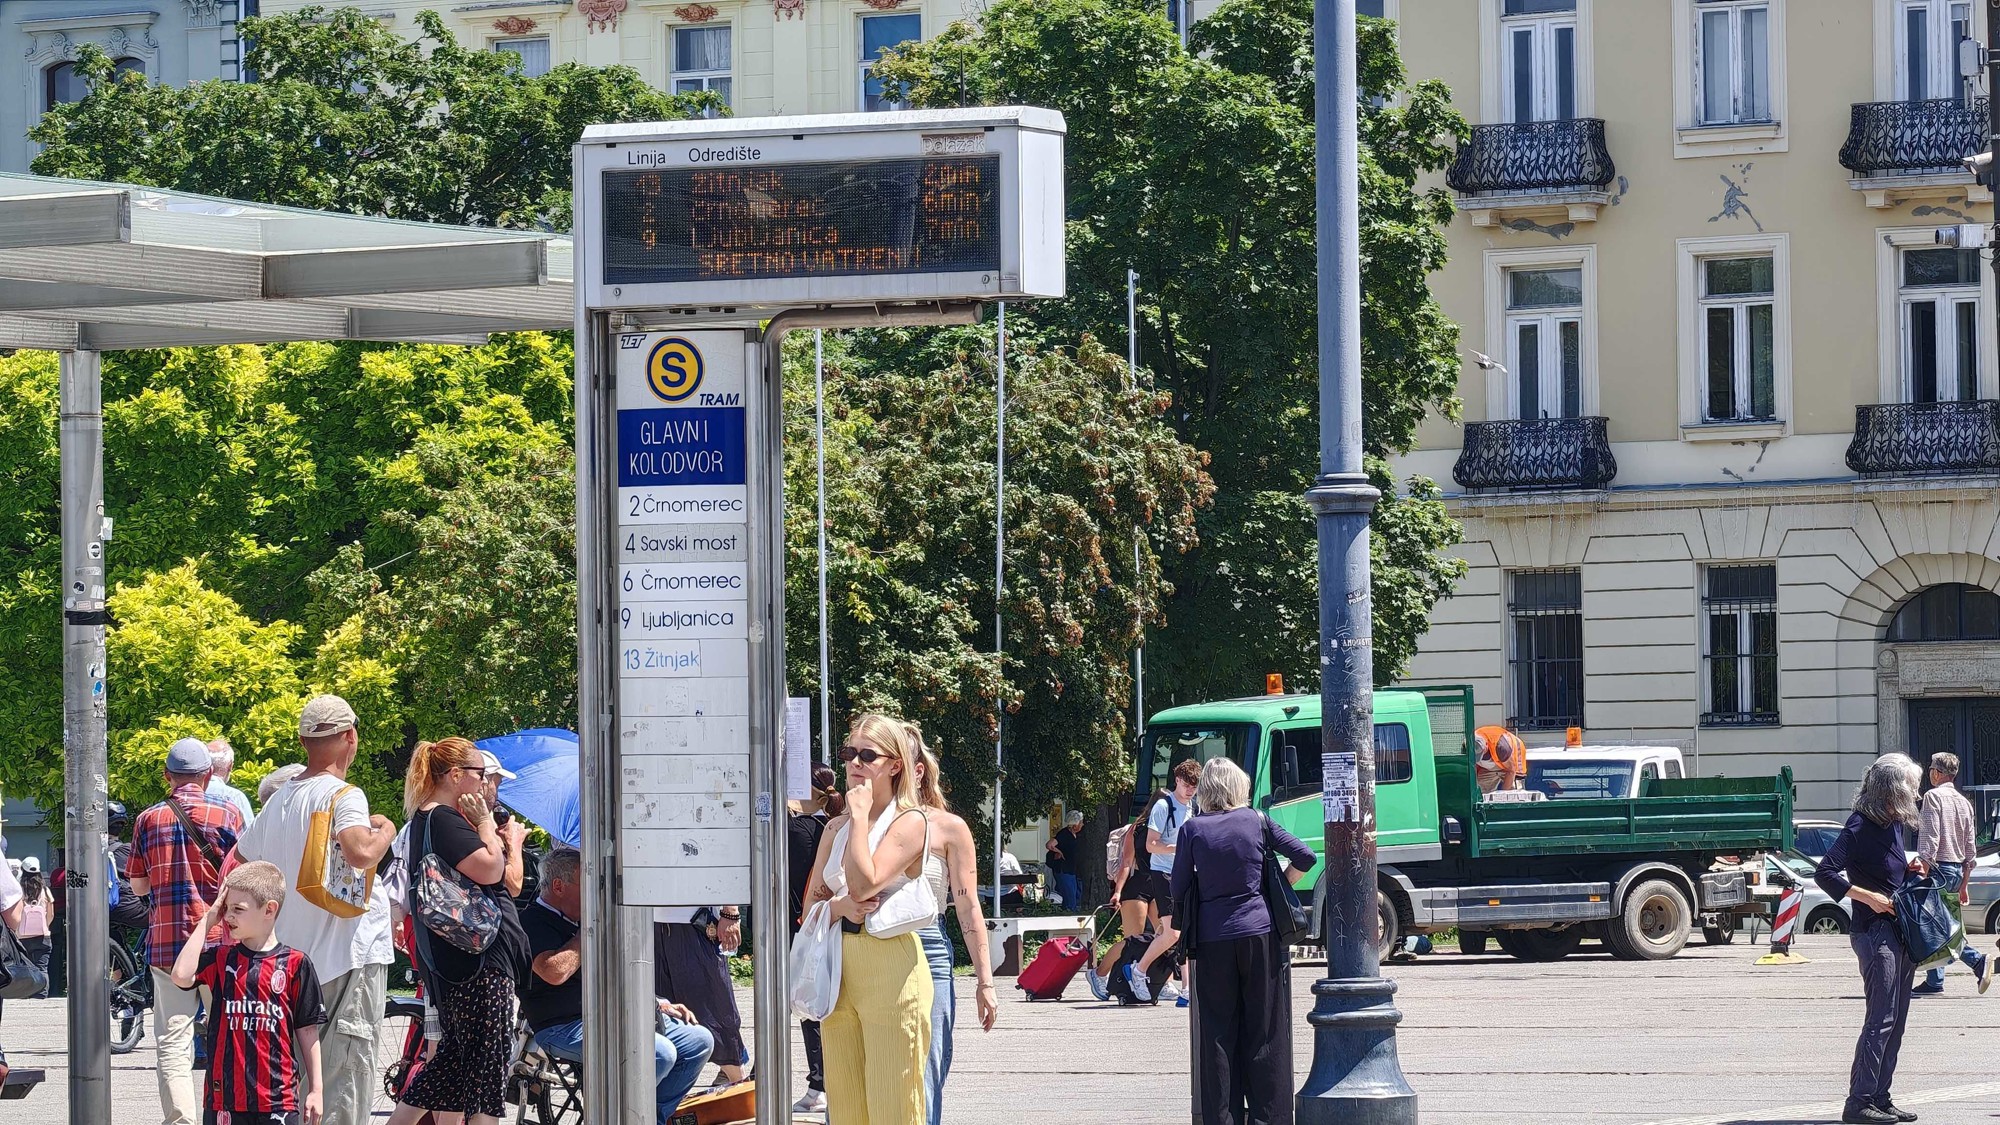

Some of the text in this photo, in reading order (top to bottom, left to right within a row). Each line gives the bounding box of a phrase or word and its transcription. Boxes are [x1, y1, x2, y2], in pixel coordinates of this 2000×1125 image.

[627, 145, 761, 168] Linija Odredište
[621, 334, 647, 349] ZET
[661, 351, 687, 388] S
[699, 393, 740, 406] TRAM
[640, 420, 708, 445] GLAVNI
[630, 450, 723, 476] KOLODVOR
[629, 493, 743, 517] 2 Črnomerec
[625, 533, 738, 554] 4 Savski most
[623, 568, 742, 592] 6 Črnomerec
[621, 607, 734, 631] 9 Ljubljanica
[623, 647, 700, 671] 13 Žitnjak
[224, 995, 285, 1019] mirates
[242, 1016, 278, 1032] BETTER
